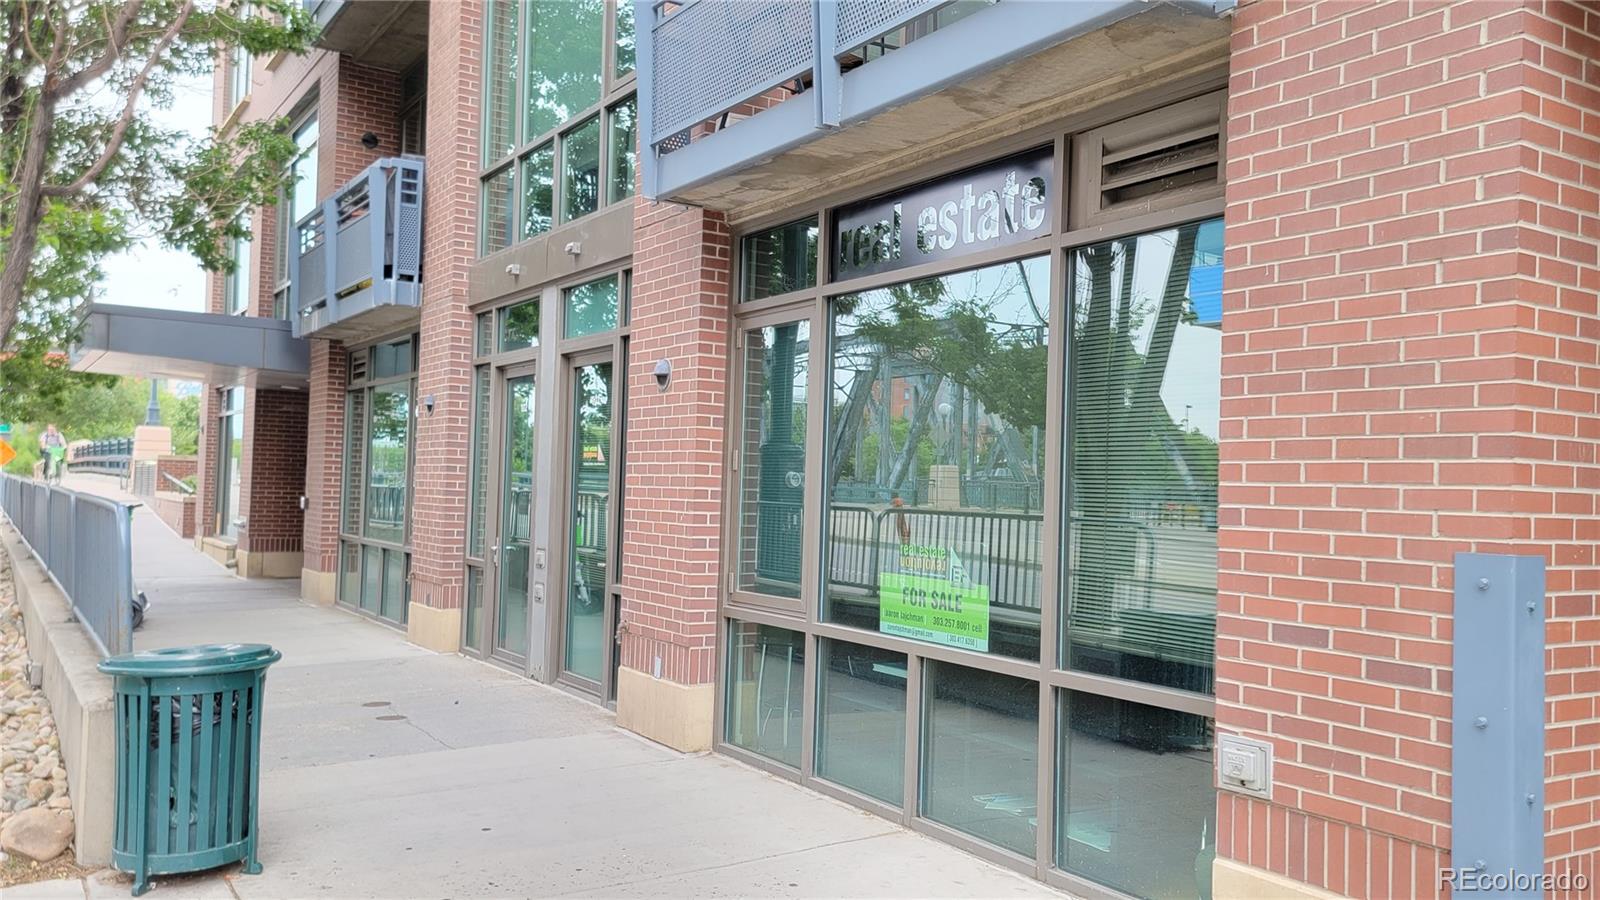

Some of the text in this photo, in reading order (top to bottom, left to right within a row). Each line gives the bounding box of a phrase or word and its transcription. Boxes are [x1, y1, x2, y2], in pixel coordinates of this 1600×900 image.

[840, 171, 1046, 272] real estate
[900, 543, 946, 560] real estate
[902, 586, 963, 613] FOR SALE
[932, 616, 970, 631] 303.257.8001
[971, 624, 983, 633] cell
